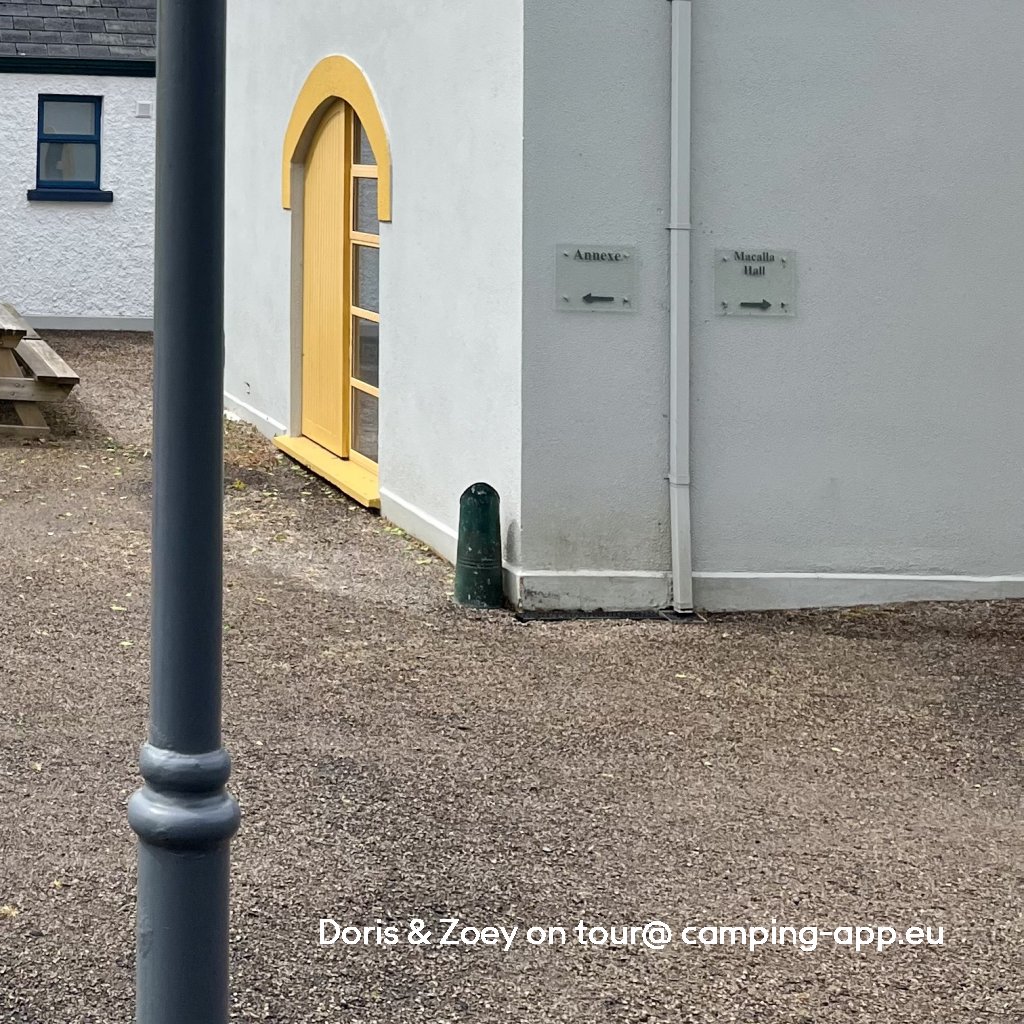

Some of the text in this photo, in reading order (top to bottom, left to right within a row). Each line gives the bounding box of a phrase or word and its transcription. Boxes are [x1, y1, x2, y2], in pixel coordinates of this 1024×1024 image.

[573, 248, 623, 262] Annexe
[734, 250, 775, 262] Macalla
[743, 265, 766, 276] Hall
